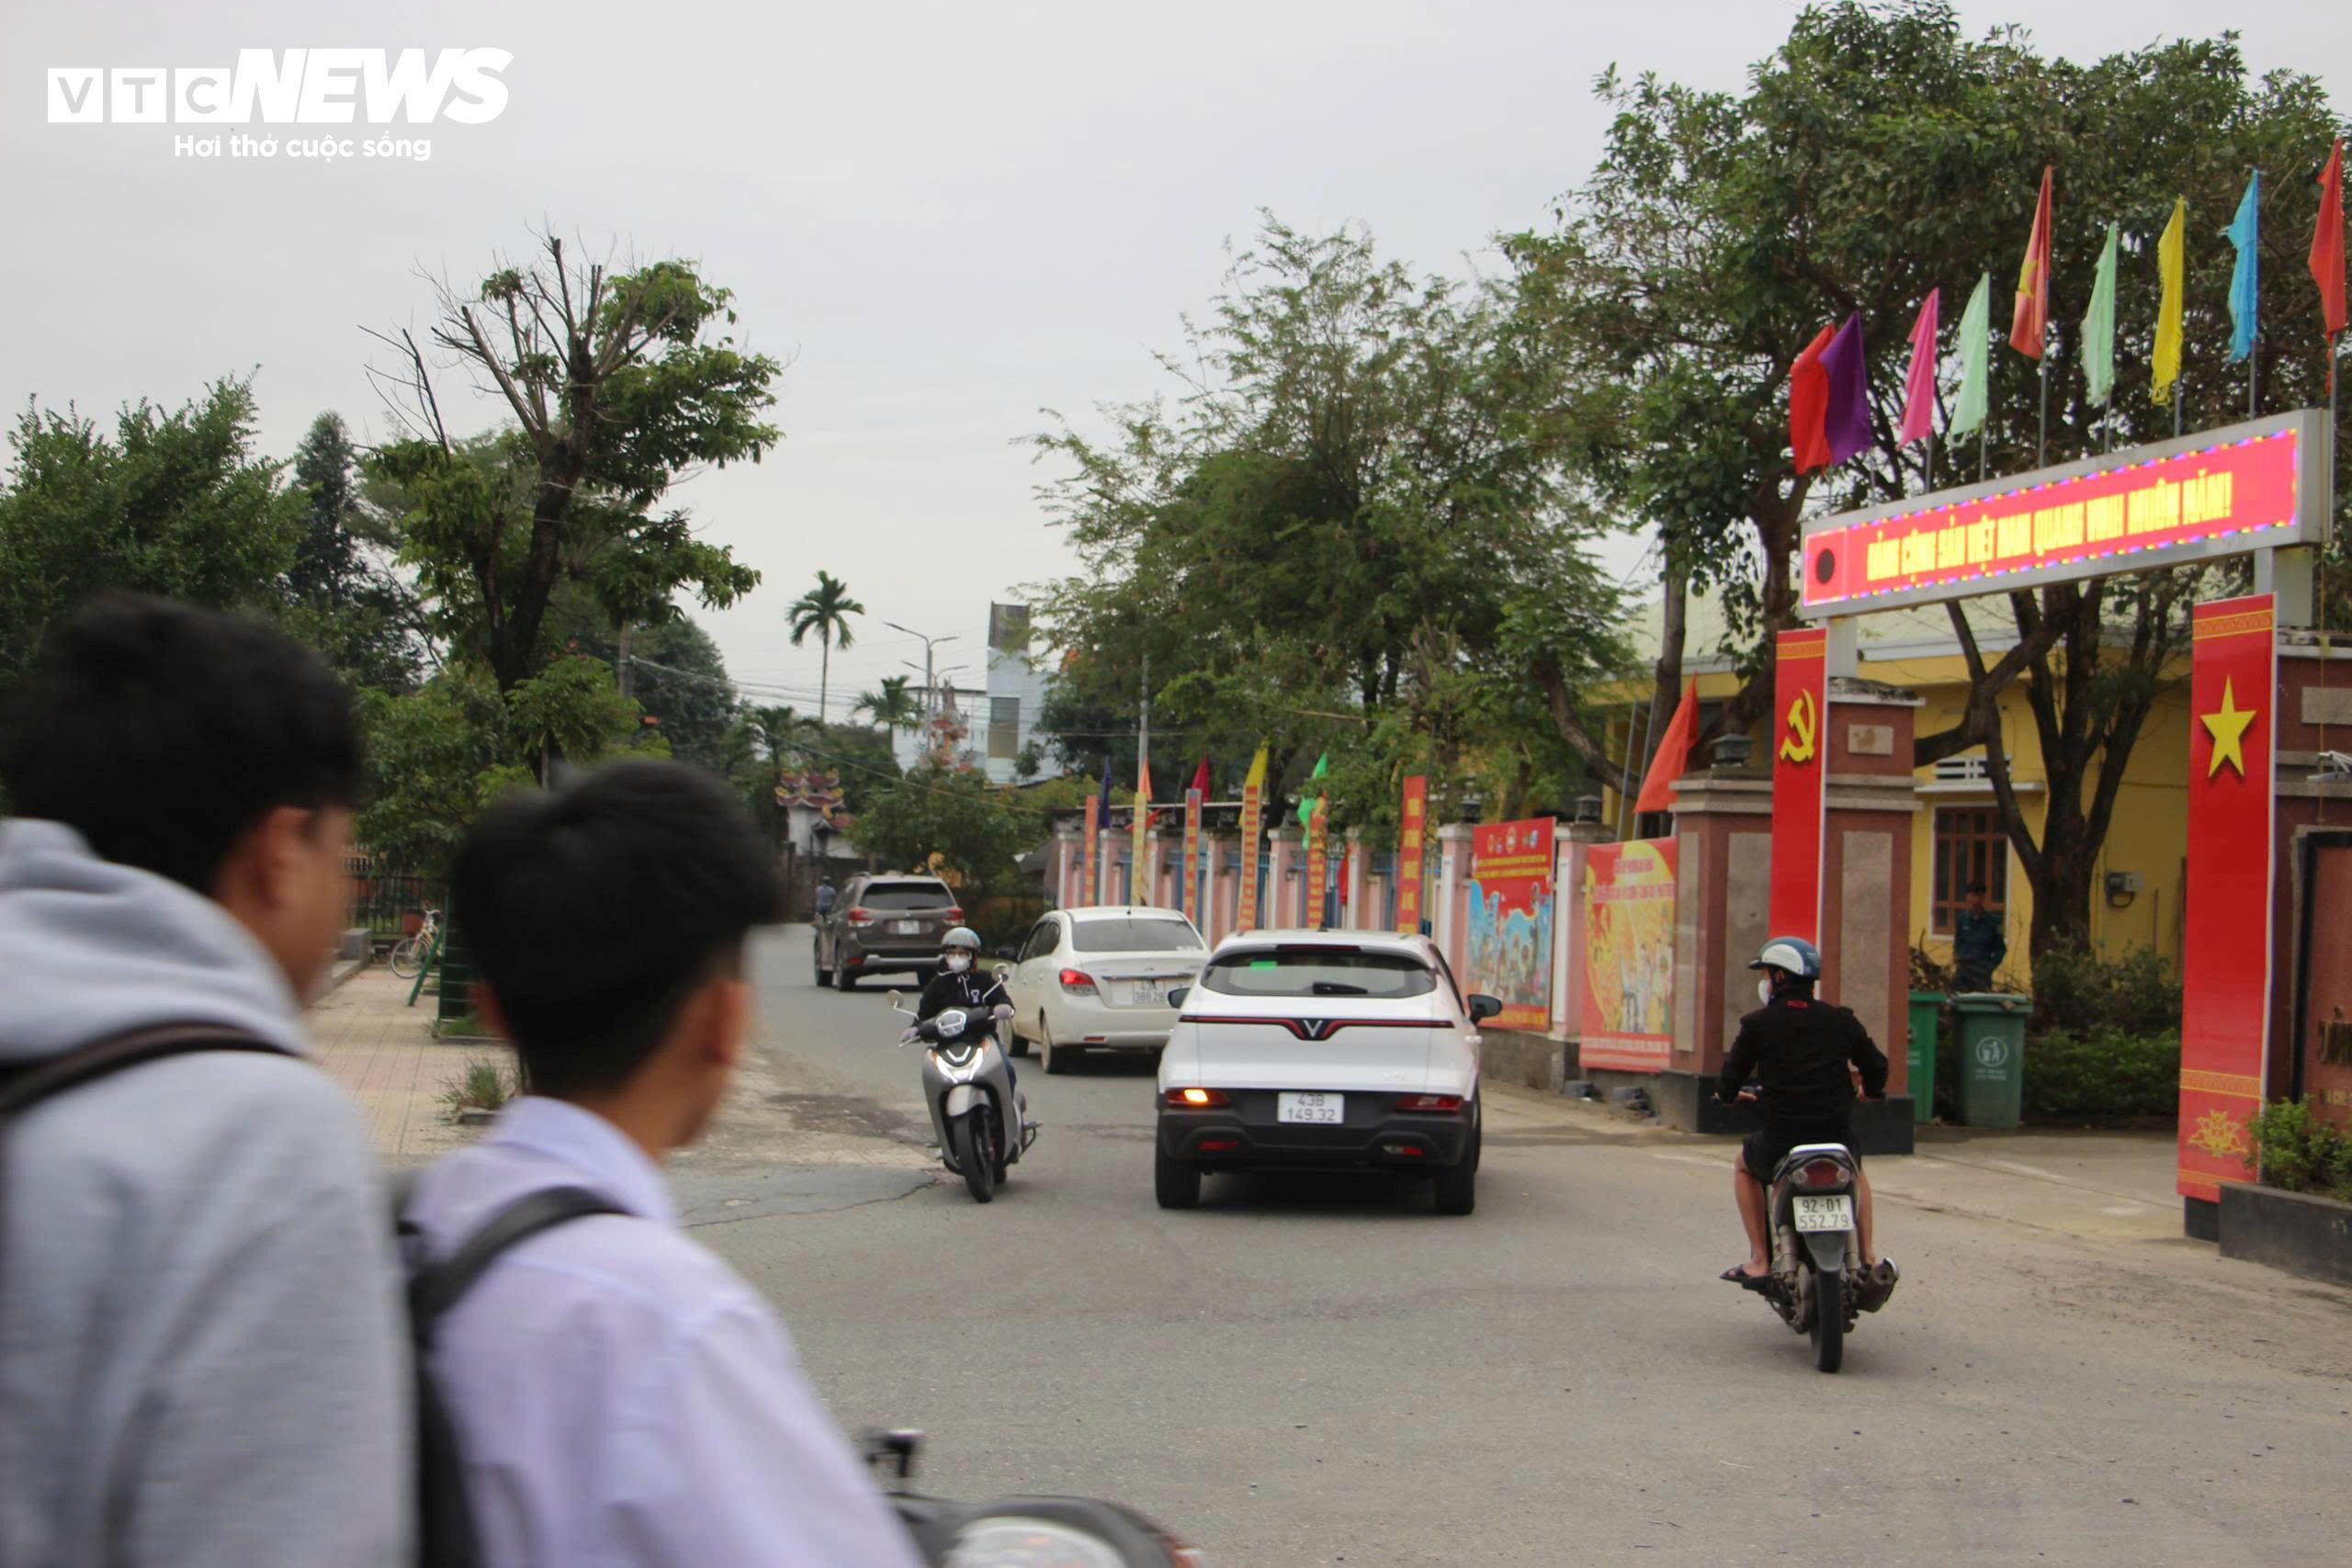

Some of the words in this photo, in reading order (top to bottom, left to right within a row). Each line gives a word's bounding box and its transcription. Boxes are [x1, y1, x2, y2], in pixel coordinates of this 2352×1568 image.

[1297, 1093, 1325, 1107] 43B
[1287, 1108, 1336, 1121] 149.32
[1799, 1213, 1849, 1229] 552.79
